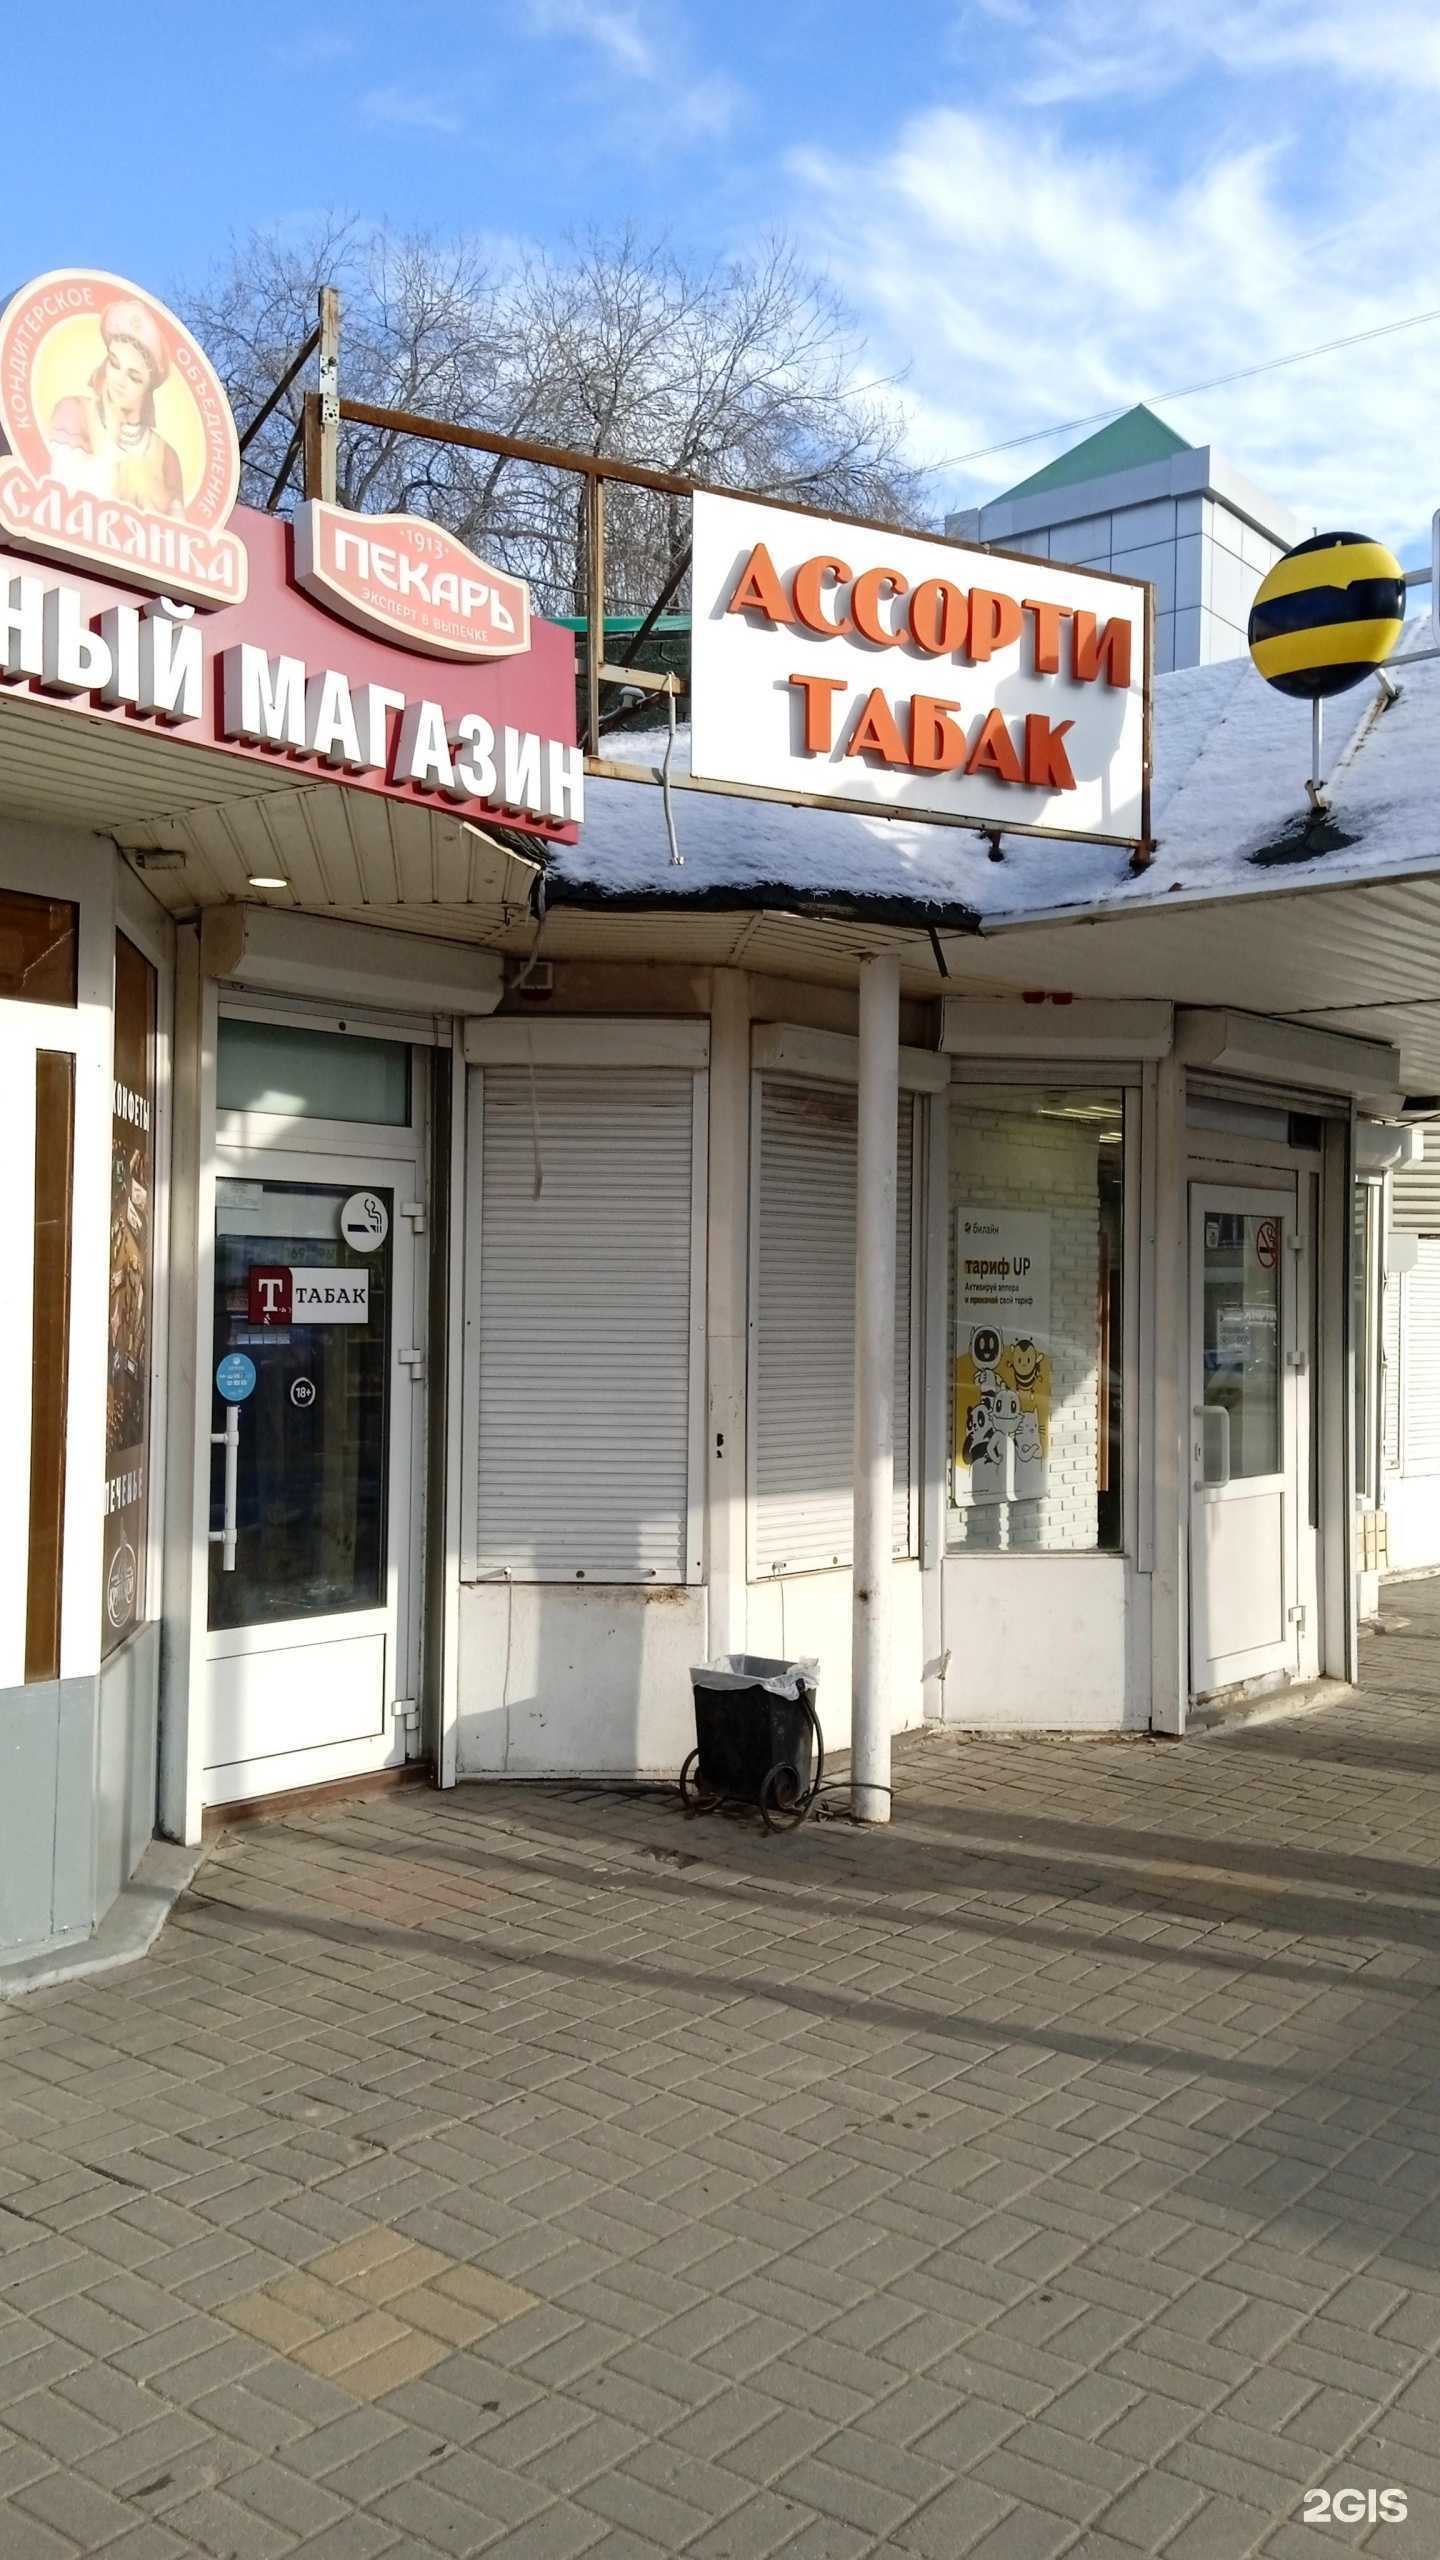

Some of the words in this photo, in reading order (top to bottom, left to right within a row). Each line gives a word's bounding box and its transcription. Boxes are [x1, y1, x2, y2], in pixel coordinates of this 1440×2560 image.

[9, 287, 94, 429] КОНДИТЕРСКОЕ
[176, 347, 227, 518] ОБЪЕДИНЕНИЕ
[3, 475, 234, 589] СЛАВЯНКА
[335, 528, 515, 634] ПЕКАРЬ
[407, 529, 444, 560] 1913
[361, 587, 419, 621] ЭКСПЕРТ
[433, 618, 489, 643] ВЫПЕЧКЕ
[728, 542, 1132, 689] АССОРТИ
[238, 643, 585, 823] МАГАЗИН
[789, 674, 1077, 791] ТАБАК
[965, 1257, 1010, 1280] тариф
[1013, 1257, 1031, 1276] UP
[972, 1222, 1000, 1234] билайн
[296, 1288, 366, 1304] ТАБАК
[295, 1386, 311, 1399] 18+
